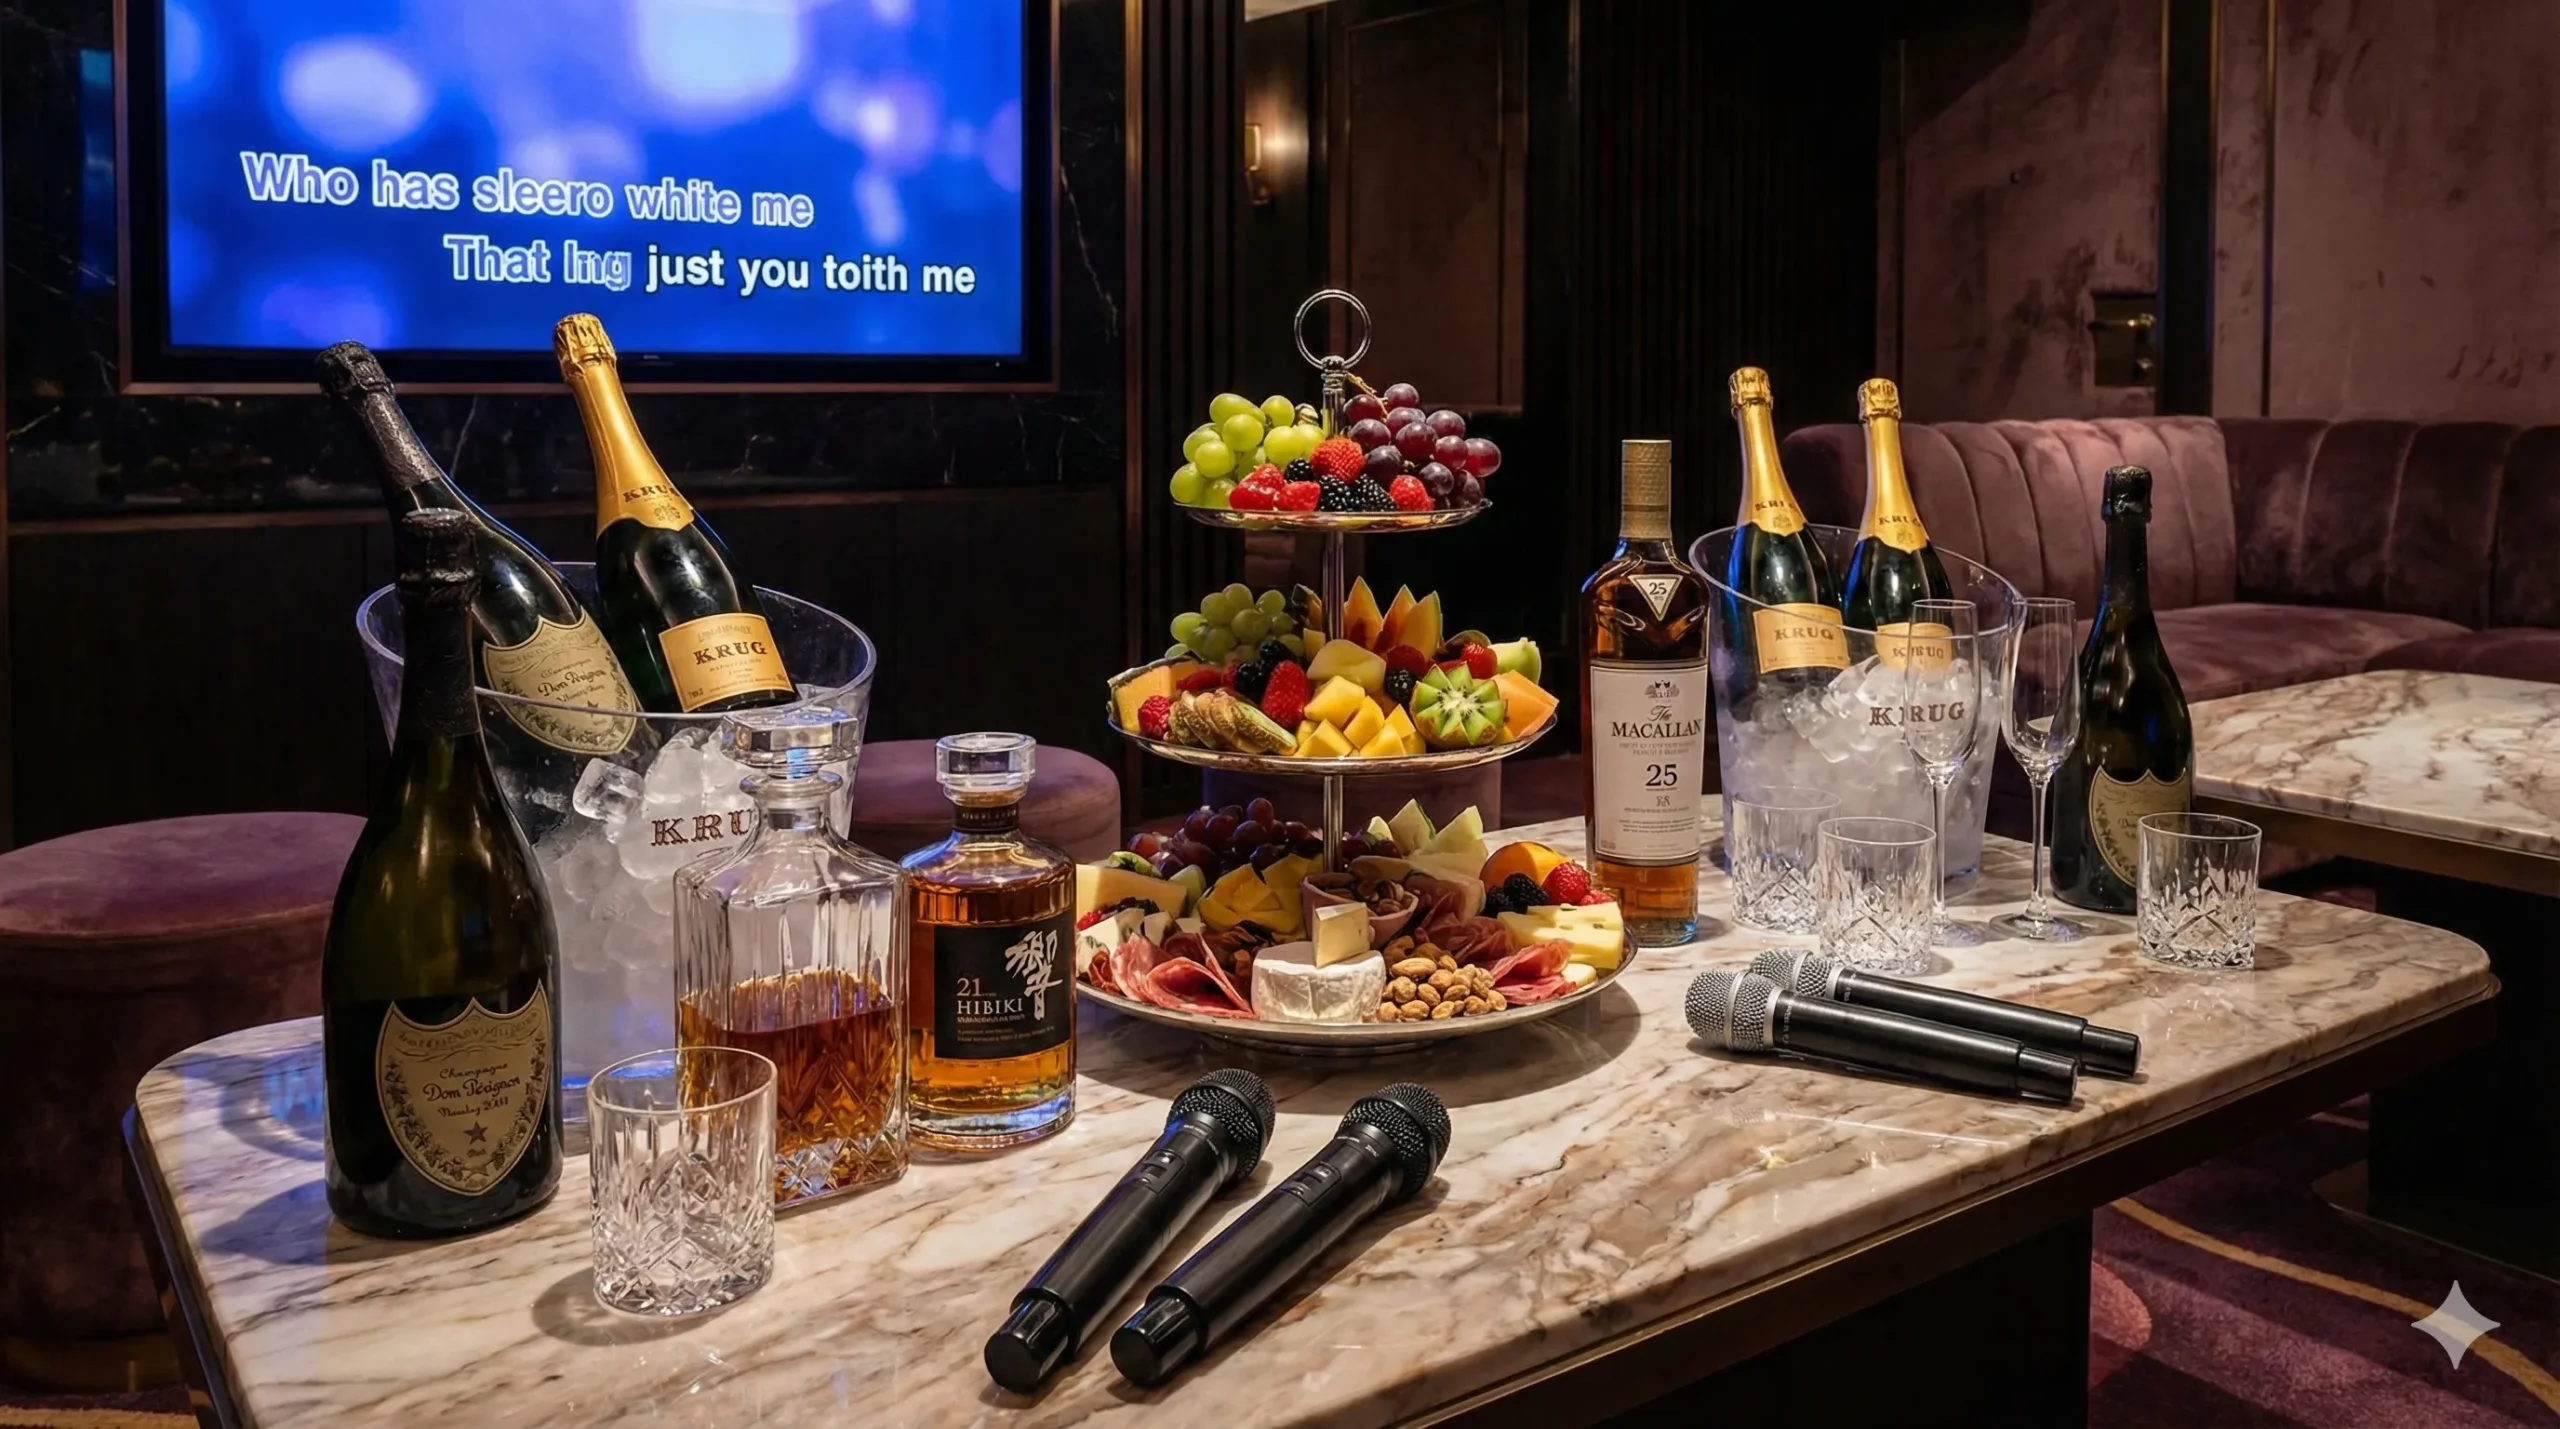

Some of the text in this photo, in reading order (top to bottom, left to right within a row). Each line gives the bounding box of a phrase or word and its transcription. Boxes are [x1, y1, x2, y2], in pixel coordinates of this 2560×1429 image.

[240, 152, 814, 228] Who has sleero white me
[443, 234, 551, 283] That
[646, 245, 725, 293] just
[738, 257, 809, 296] you
[823, 254, 907, 292] toith
[922, 264, 976, 293] me
[1648, 582, 1668, 596] 25
[692, 641, 768, 666] KRUG
[1611, 719, 1702, 739] MACALLAN
[1645, 763, 1678, 787] 25
[650, 808, 756, 847] KRU
[956, 978, 981, 997] 21
[956, 998, 1023, 1015] HIBIKI
[422, 1083, 461, 1102] Dom
